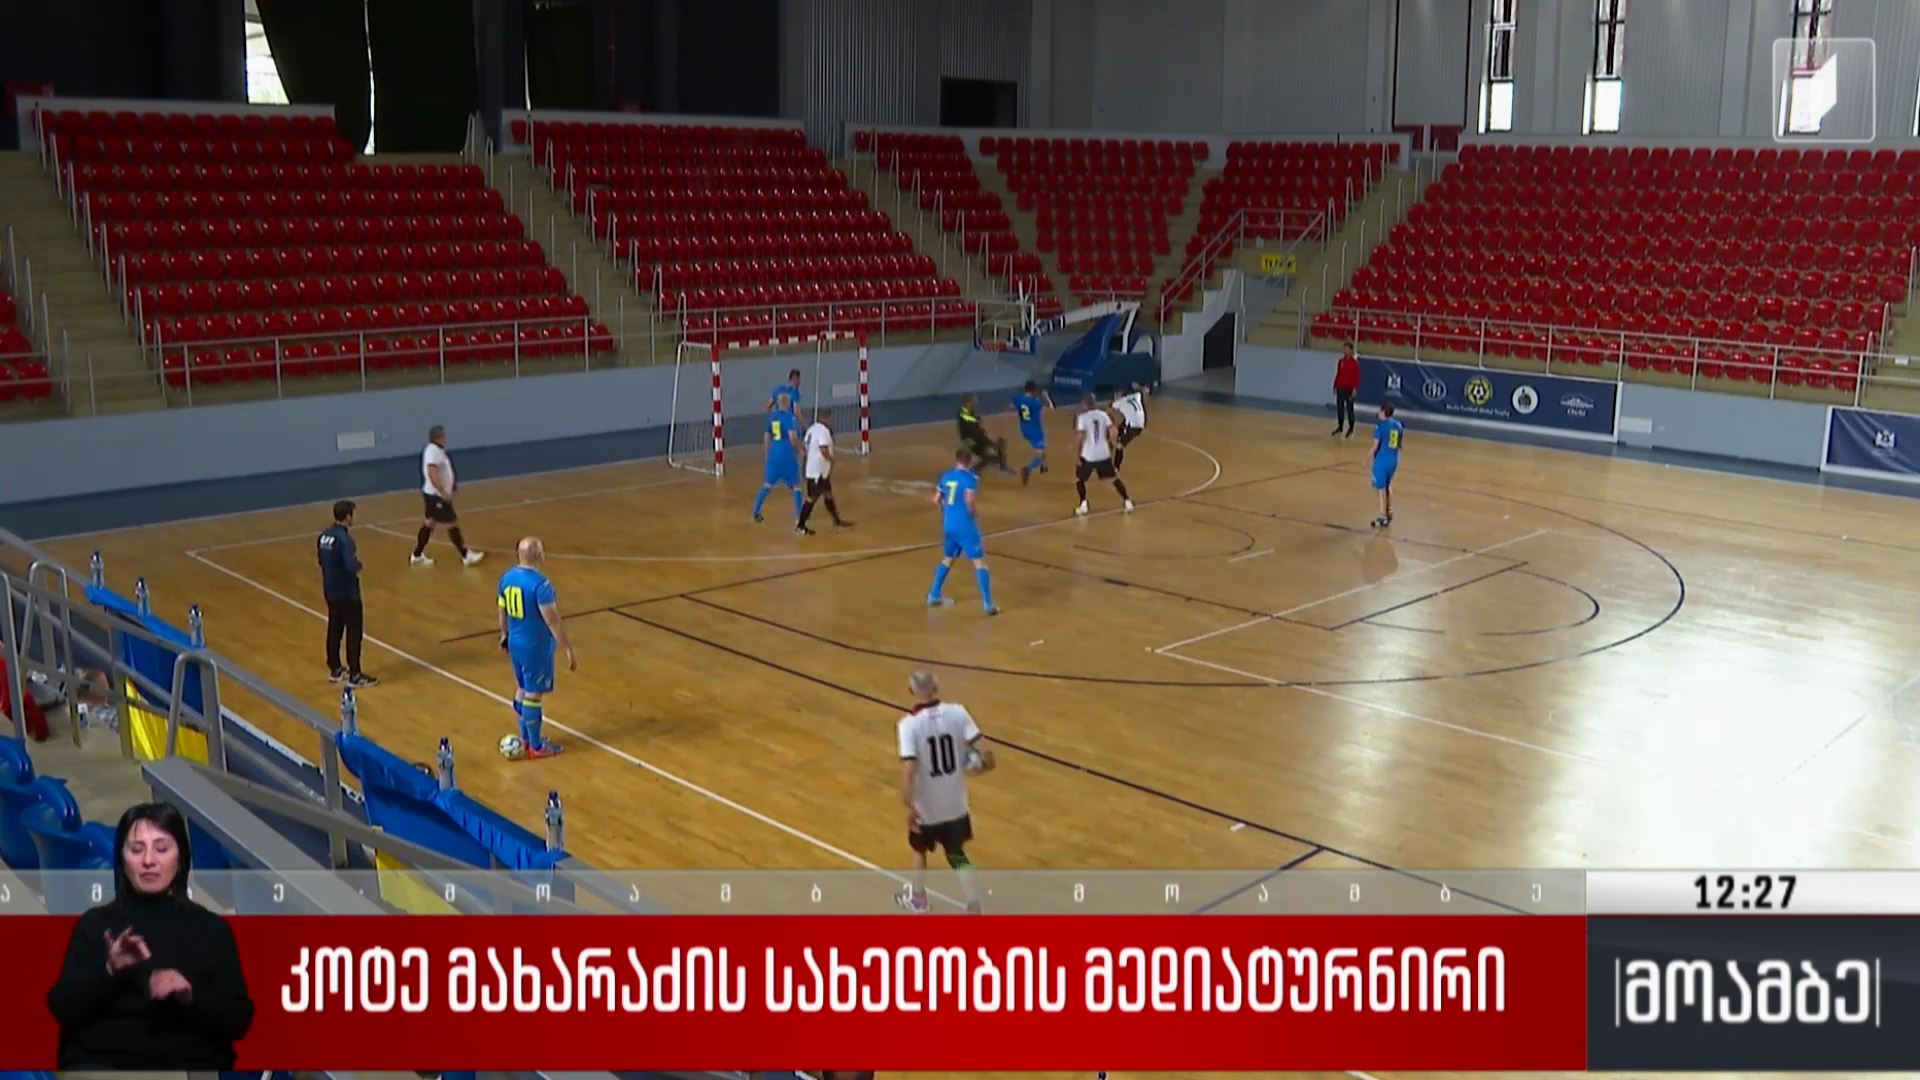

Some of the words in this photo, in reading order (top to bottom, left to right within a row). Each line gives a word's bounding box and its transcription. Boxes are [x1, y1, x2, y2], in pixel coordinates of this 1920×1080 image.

[1021, 404, 1031, 421] 2
[771, 420, 782, 441] 9
[1389, 429, 1399, 449] 8
[945, 480, 958, 505] 7
[503, 585, 524, 619] 10
[927, 733, 956, 777] 10
